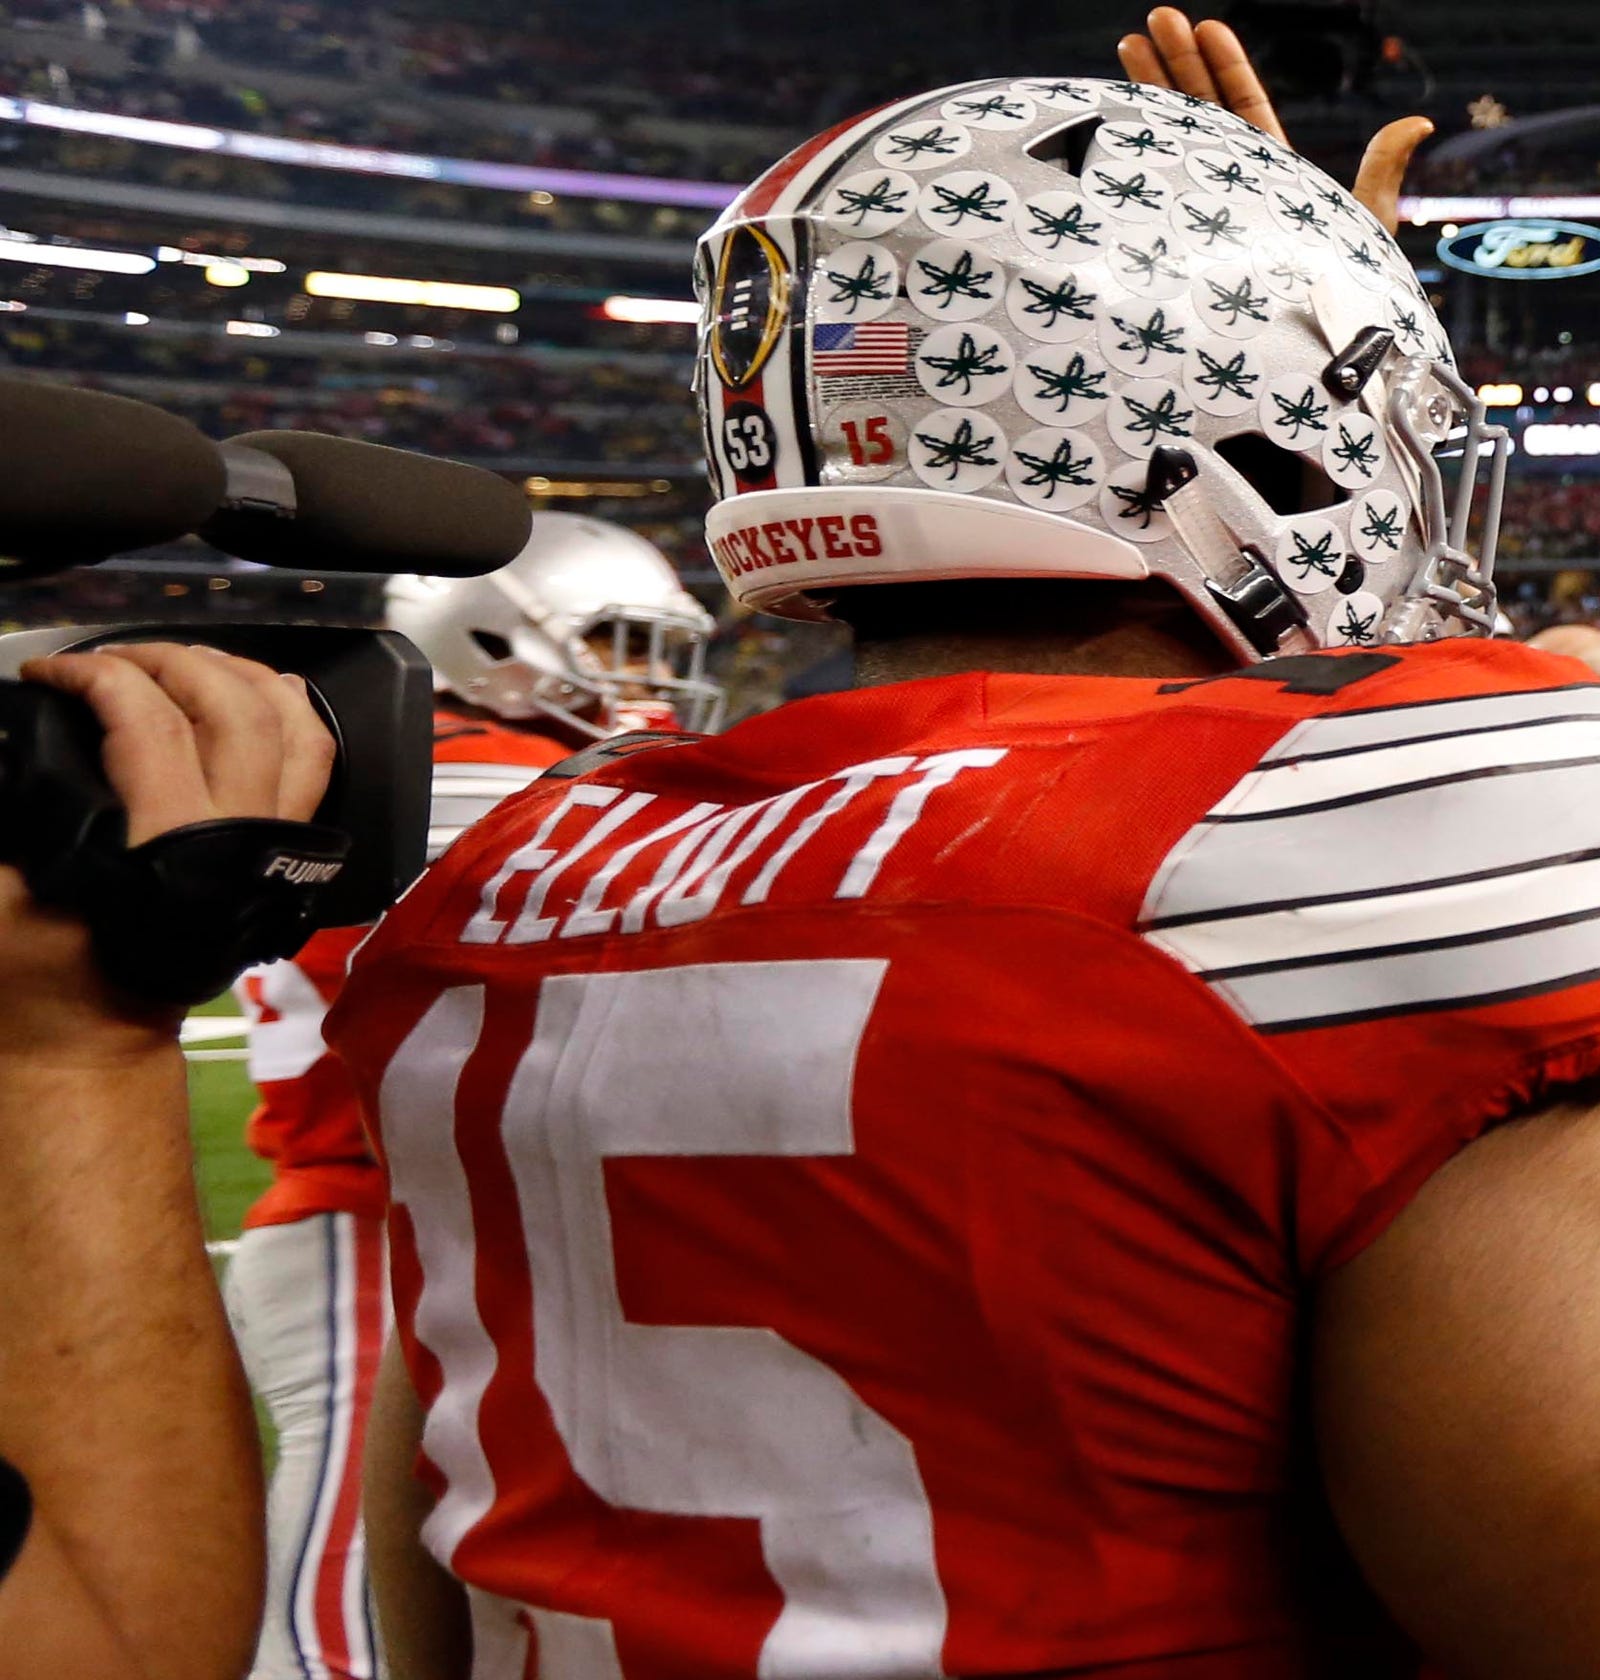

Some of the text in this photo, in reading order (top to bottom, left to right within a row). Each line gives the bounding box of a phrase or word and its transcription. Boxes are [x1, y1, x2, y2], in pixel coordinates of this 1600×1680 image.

[1473, 225, 1587, 268] Ford
[724, 415, 771, 471] 53
[840, 416, 896, 467] 15
[714, 514, 883, 578] UCKEYES
[459, 748, 1010, 945] ELLIOTT
[379, 958, 948, 1680] 15
